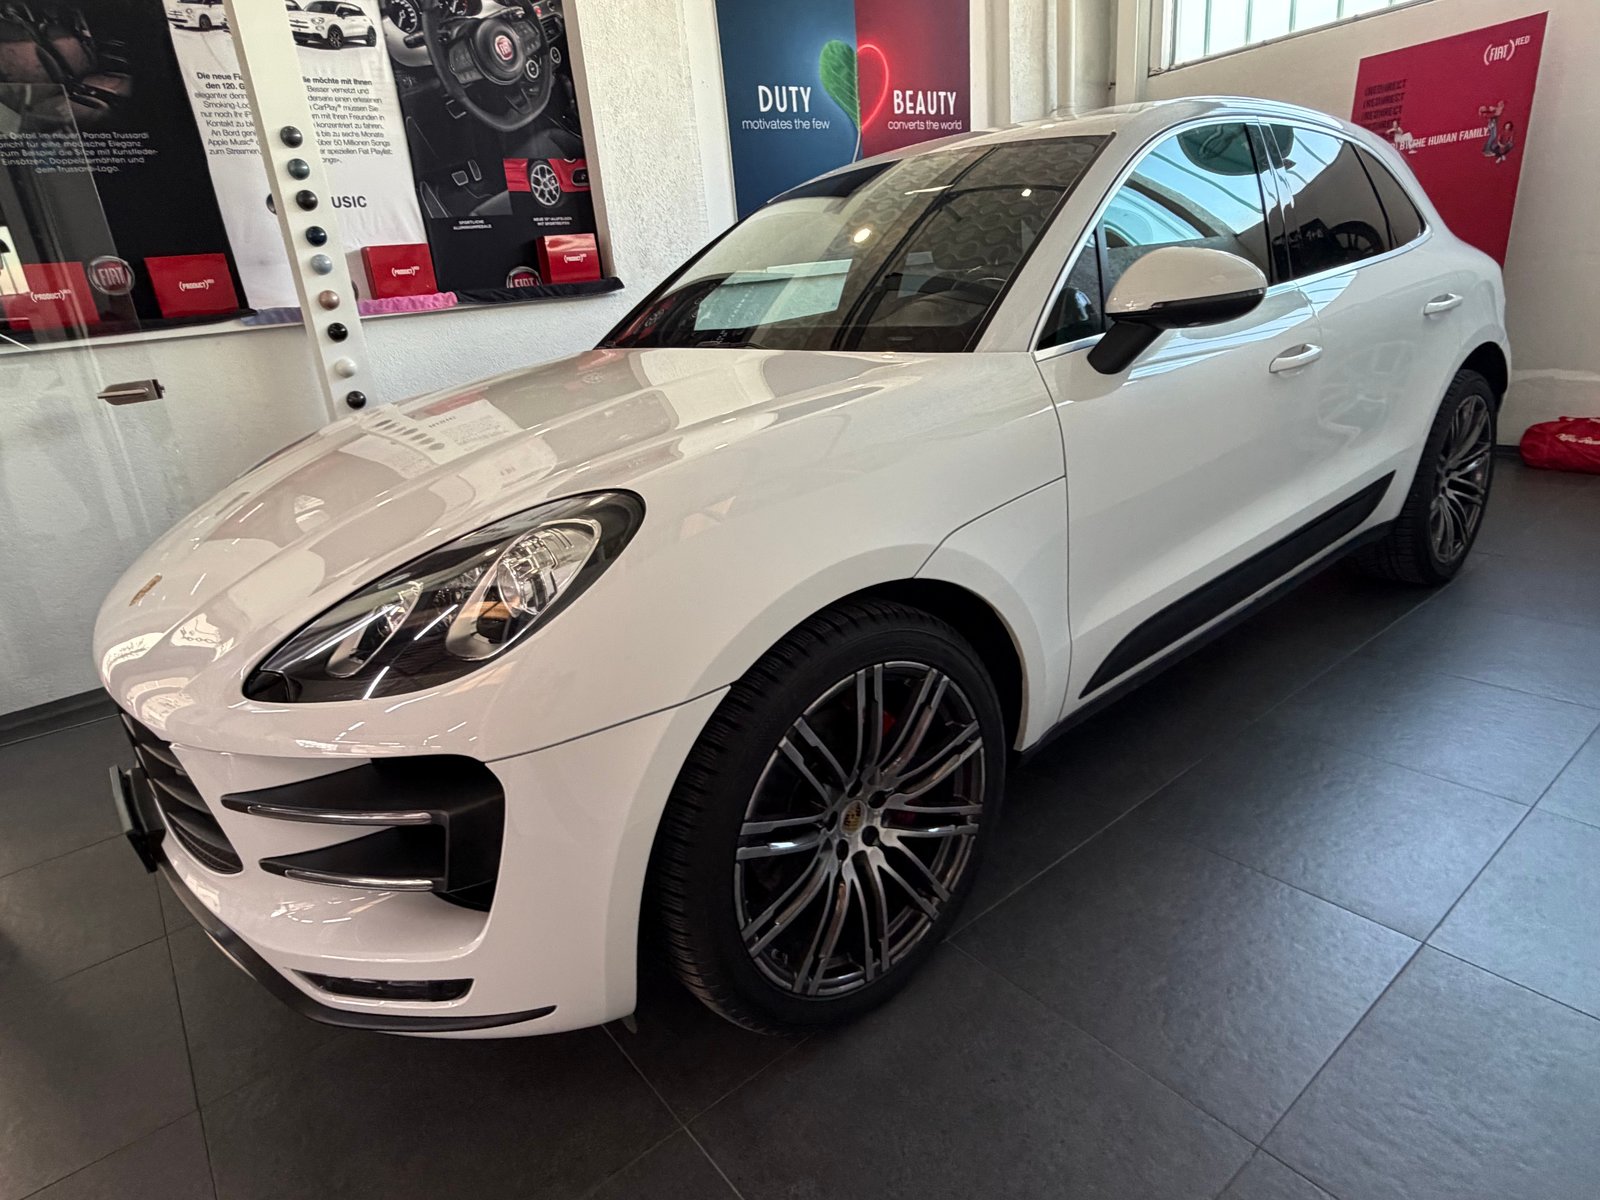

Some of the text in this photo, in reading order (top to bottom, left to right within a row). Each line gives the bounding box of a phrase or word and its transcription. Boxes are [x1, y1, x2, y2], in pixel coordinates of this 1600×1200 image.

[196, 72, 210, 80] Die
[312, 76, 339, 84] möchte
[354, 78, 372, 86] Ihnen
[206, 82, 220, 90] den
[222, 82, 238, 90] 120.
[758, 85, 811, 113] DUTY
[893, 89, 956, 116] BEAUTY
[332, 113, 349, 121] Ihren
[349, 113, 378, 121] Freunden
[206, 120, 234, 128] Kontakt
[742, 118, 830, 130] motivates the few
[888, 120, 962, 130] converts the world
[82, 132, 112, 140] Panda
[223, 129, 241, 137] Bord
[208, 139, 229, 147] Apple
[371, 139, 391, 148] Songs
[1428, 132, 1458, 146] HUMAN
[331, 196, 367, 209] USIC
[98, 266, 126, 287] FIAT
